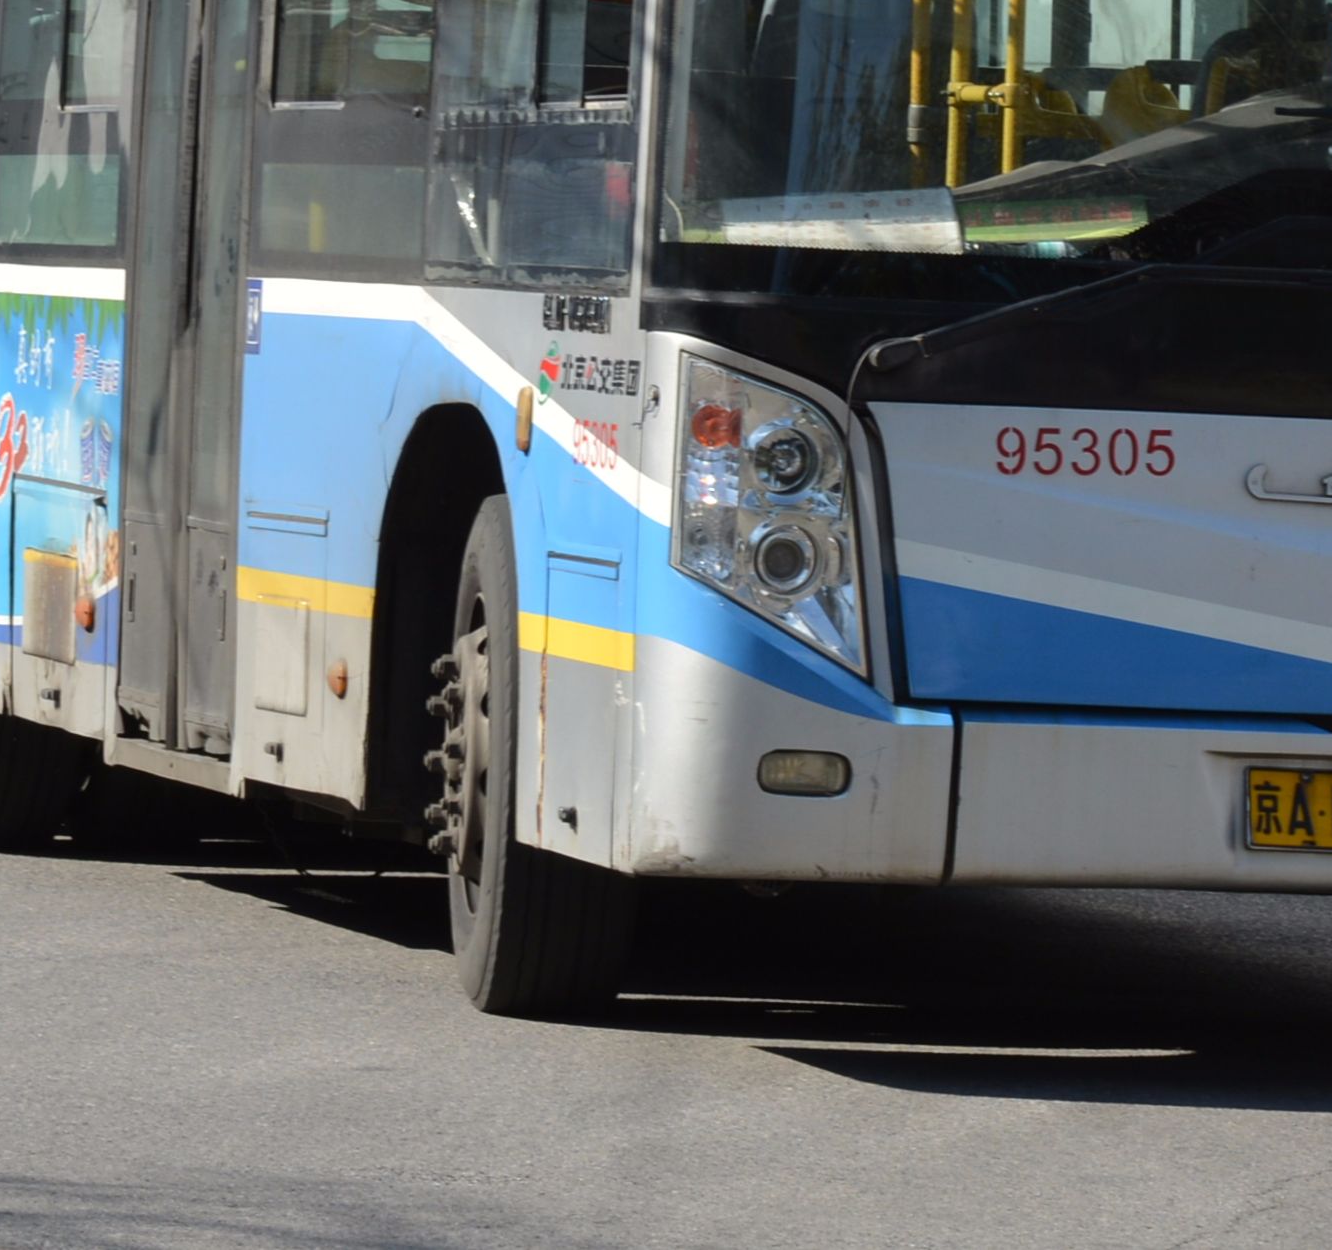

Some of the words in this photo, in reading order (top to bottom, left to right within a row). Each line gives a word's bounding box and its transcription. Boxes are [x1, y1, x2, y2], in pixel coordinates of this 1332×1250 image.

[562, 354, 640, 396] 北京公交集团
[574, 419, 617, 470] 95305
[996, 426, 1176, 477] 95305
